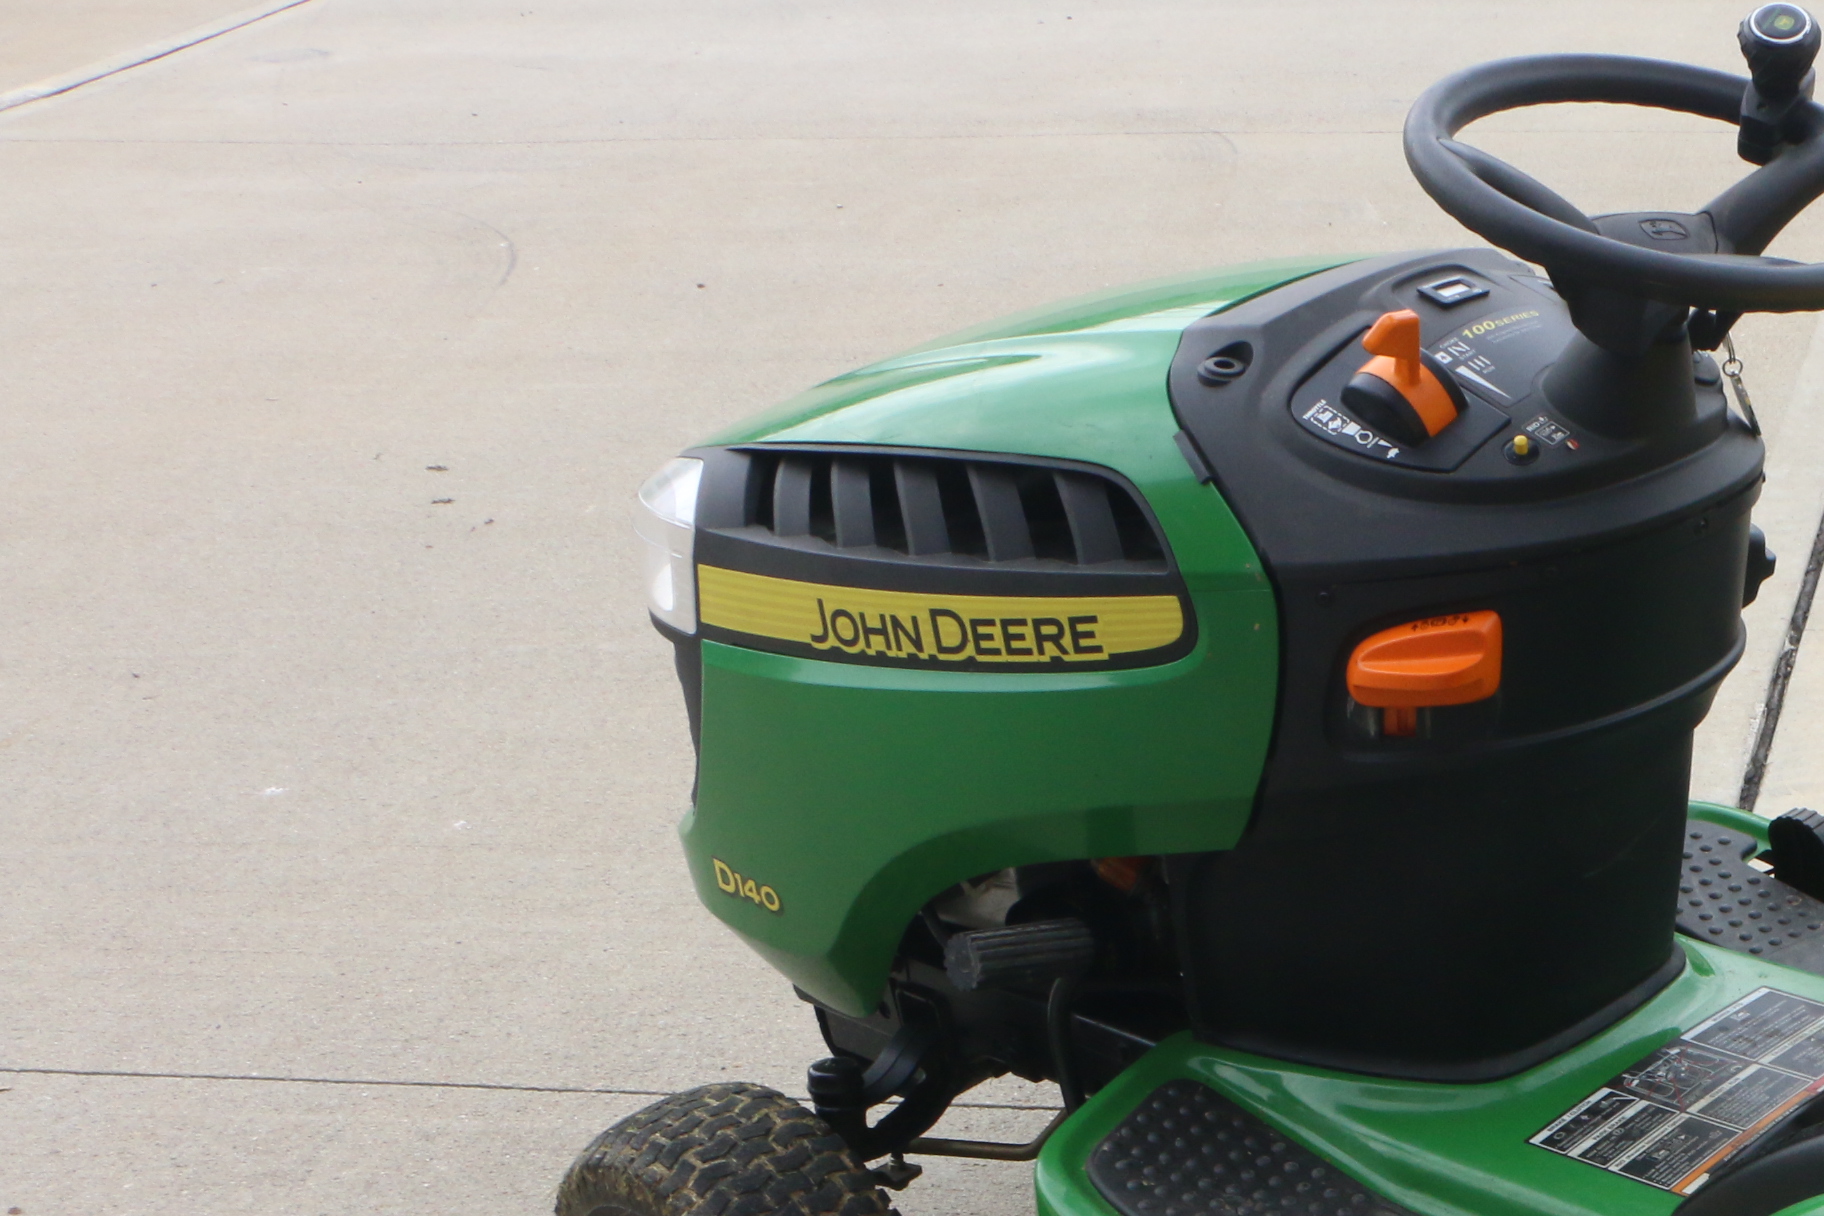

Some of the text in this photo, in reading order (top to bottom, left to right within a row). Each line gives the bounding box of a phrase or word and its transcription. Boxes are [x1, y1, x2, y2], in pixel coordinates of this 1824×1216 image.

[810, 598, 1103, 656] JOHN DEERE
[713, 858, 780, 912] D140
